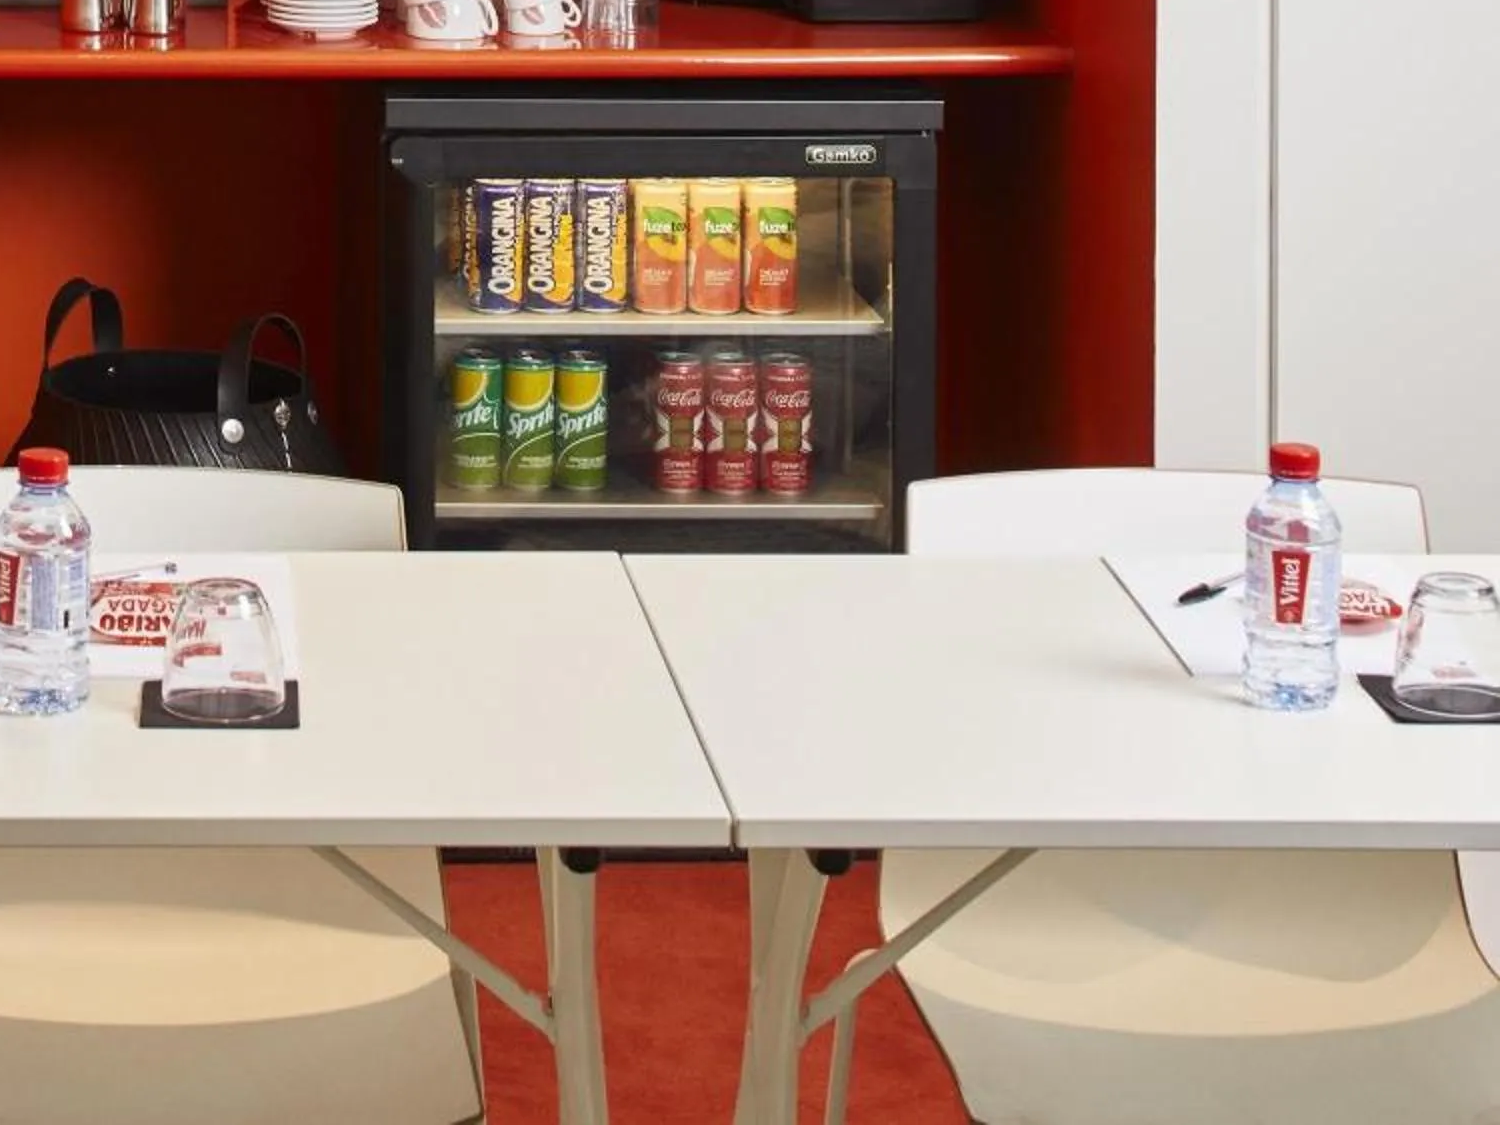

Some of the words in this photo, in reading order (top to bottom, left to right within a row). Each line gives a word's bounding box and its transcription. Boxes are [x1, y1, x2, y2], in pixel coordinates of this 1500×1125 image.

[487, 196, 516, 295] ORANGINA
[527, 195, 556, 293] ORANGINA
[583, 195, 613, 294] ORANGINA
[455, 400, 492, 428] rite
[1279, 557, 1301, 606] Vittel
[99, 613, 172, 633] ARIBO
